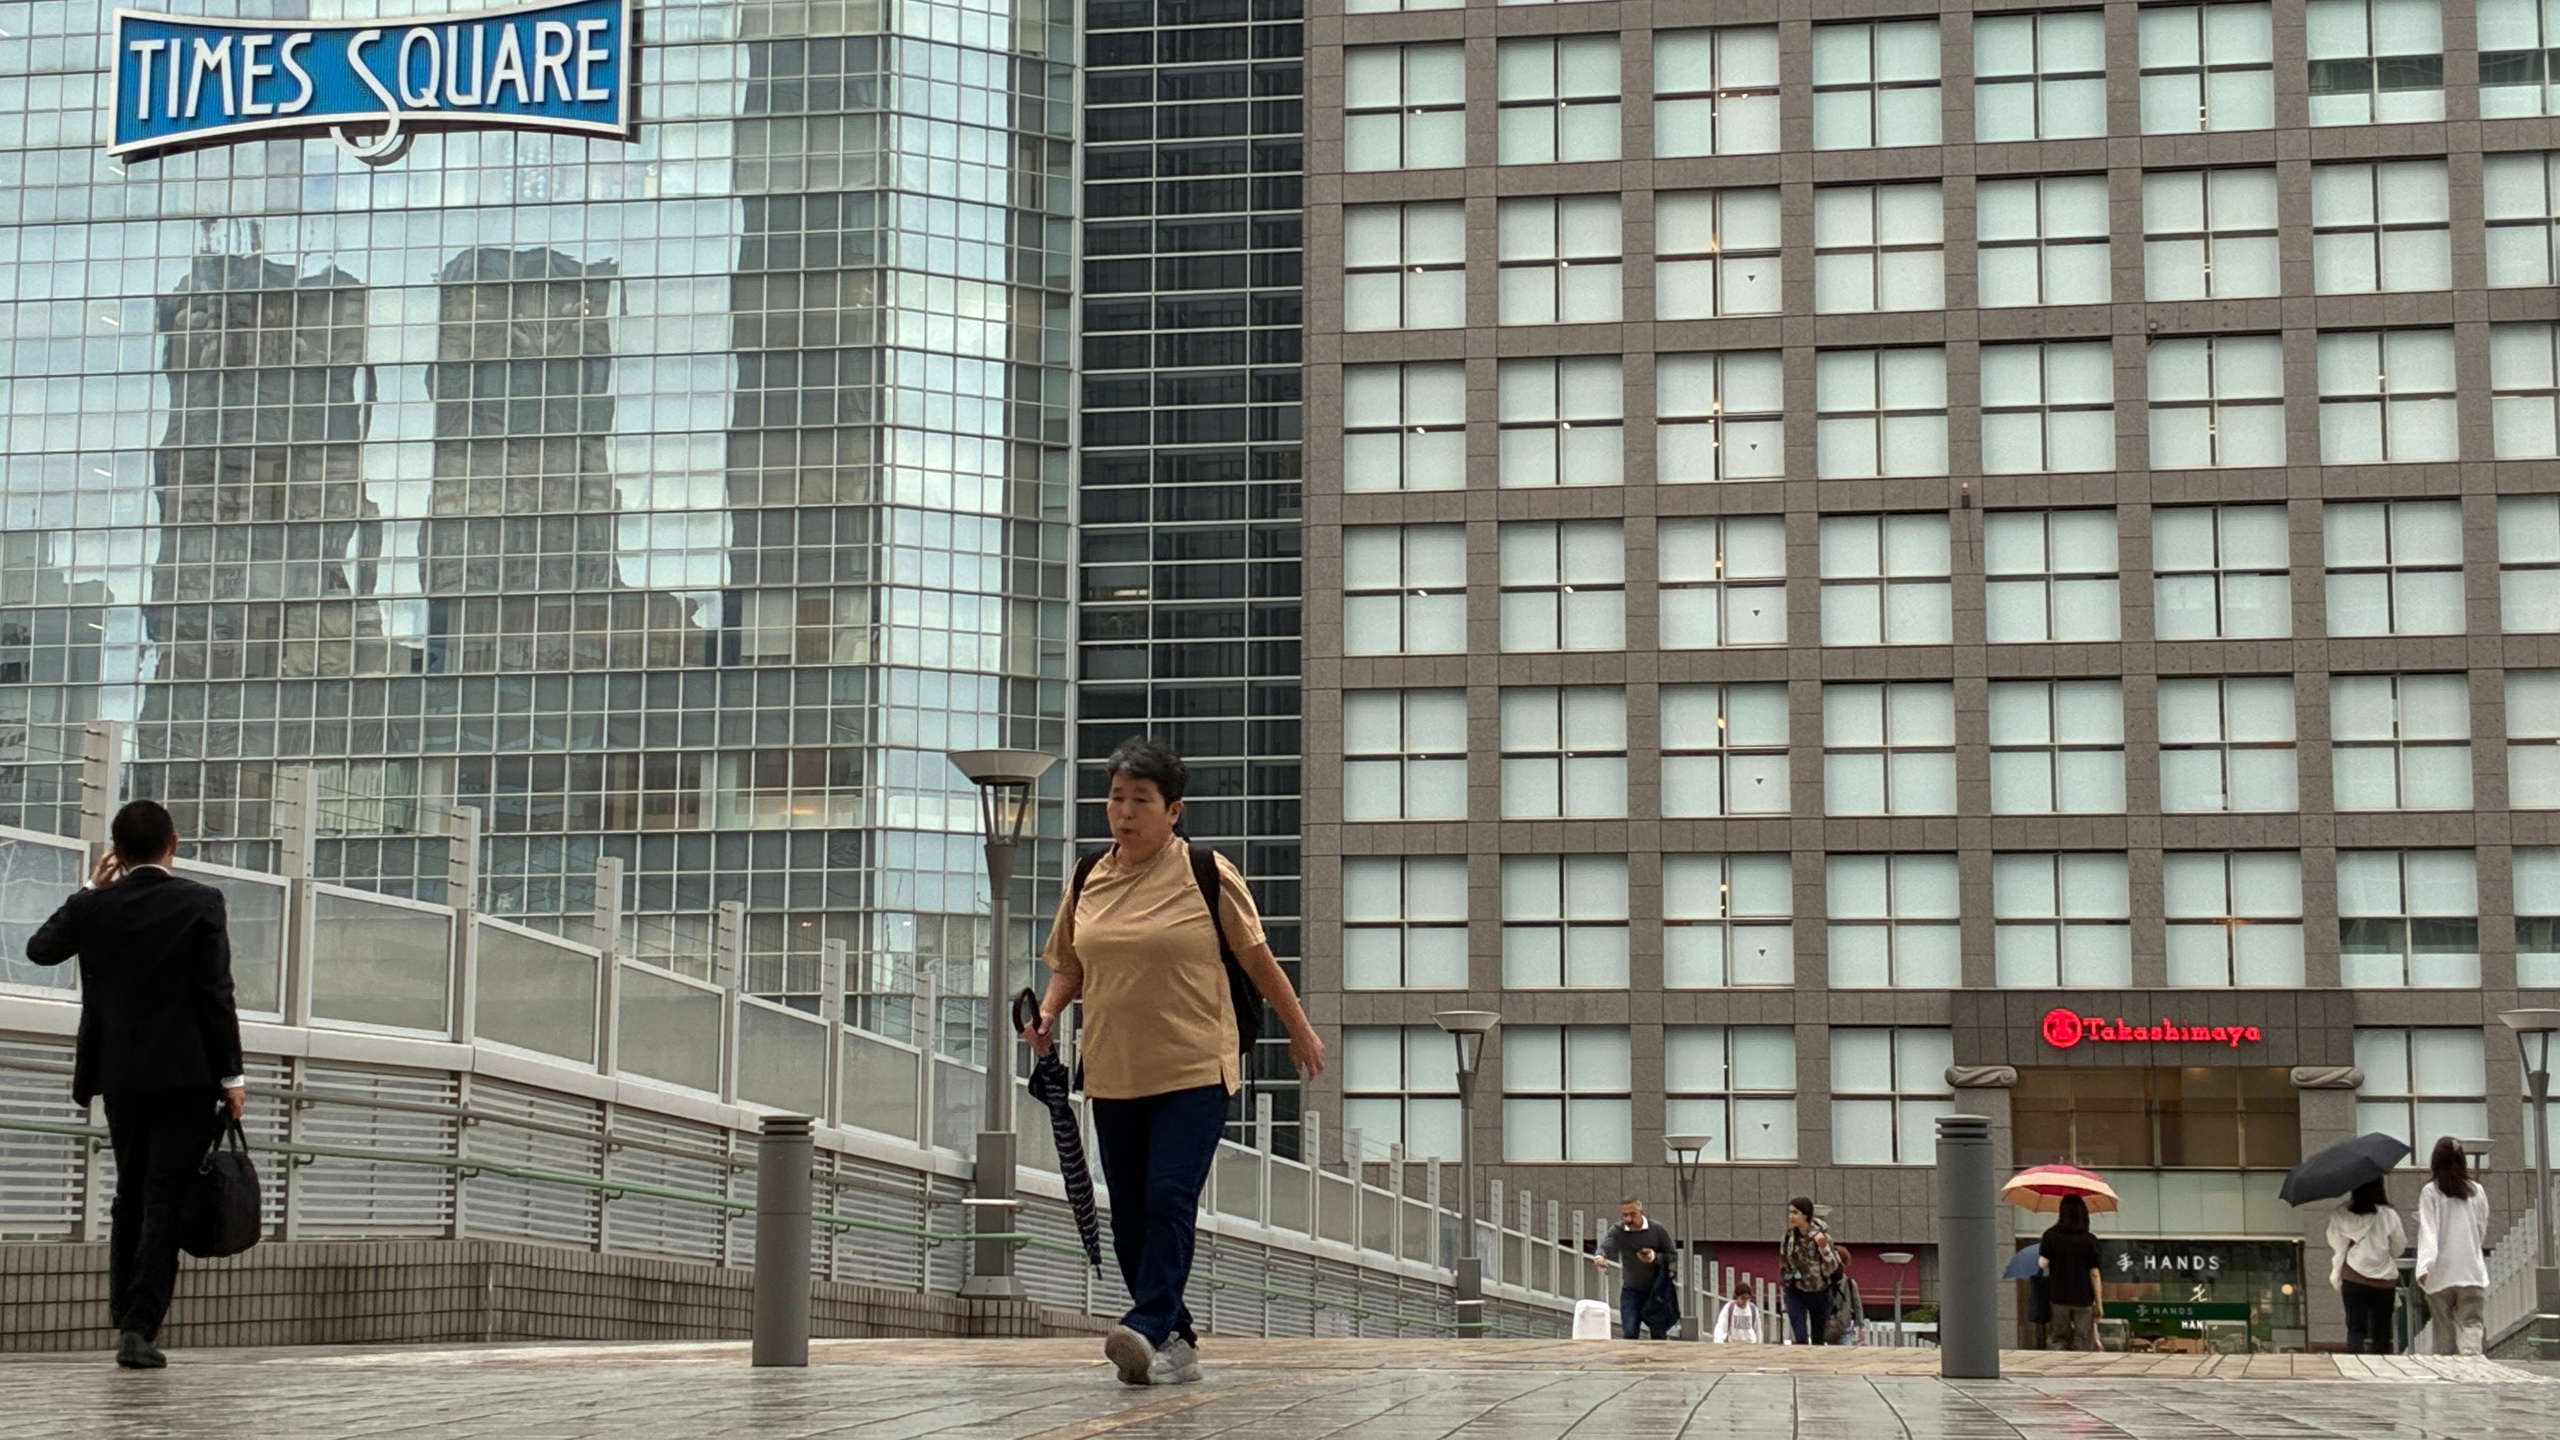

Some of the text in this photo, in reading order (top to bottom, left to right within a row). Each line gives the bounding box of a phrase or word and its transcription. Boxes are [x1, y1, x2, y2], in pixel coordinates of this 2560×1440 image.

[129, 19, 611, 158] TIMES SQUARE
[2082, 1017, 2262, 1047] Takashimaya
[2144, 1255, 2220, 1270] HANDS
[2153, 1307, 2194, 1315] HANDS
